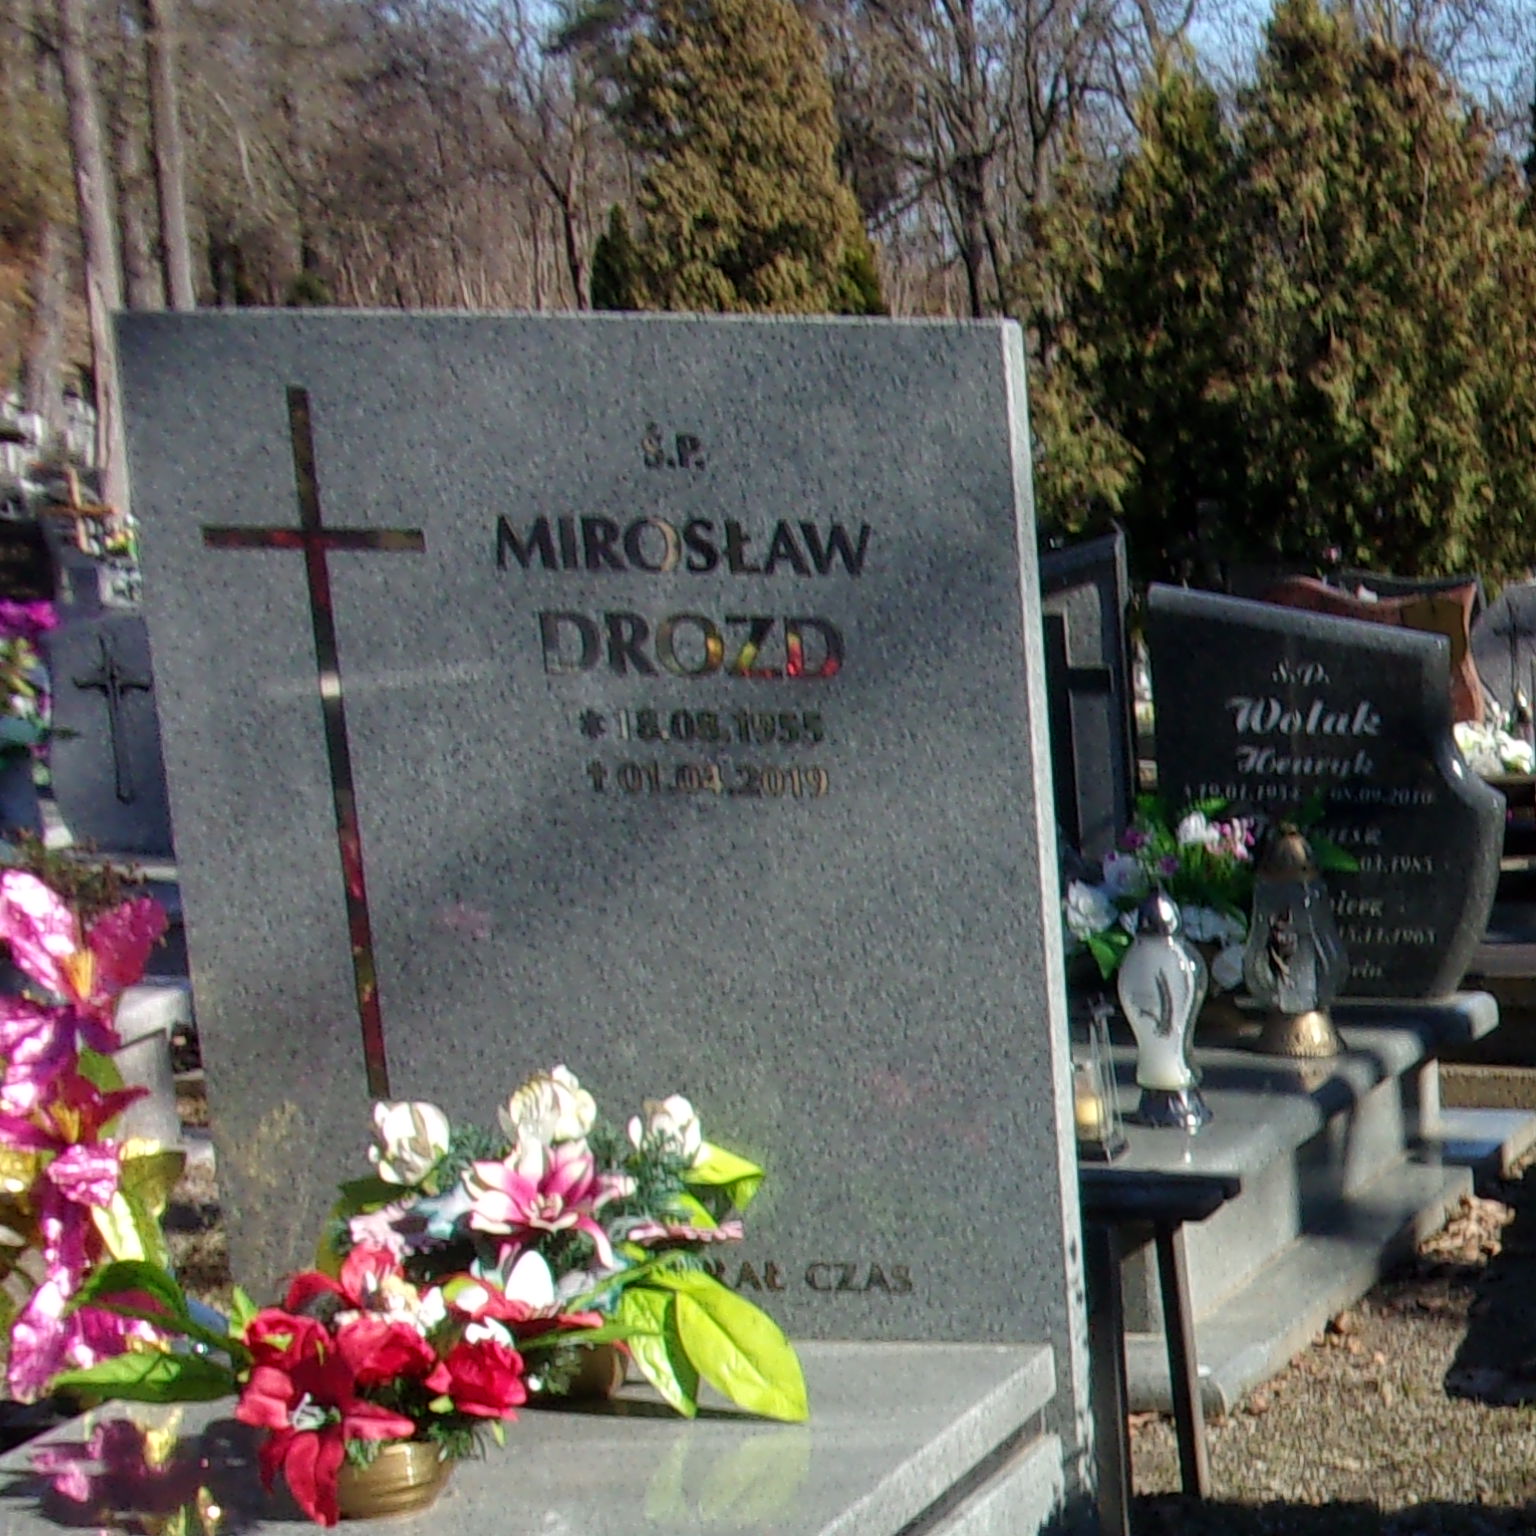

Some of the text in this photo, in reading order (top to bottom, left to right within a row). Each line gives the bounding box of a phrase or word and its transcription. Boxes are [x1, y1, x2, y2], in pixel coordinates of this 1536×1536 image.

[496, 514, 871, 577] MIROSŁAW
[539, 610, 846, 679] DROZD
[1224, 696, 1384, 737] Wolak
[804, 1261, 913, 1294] CZAS
